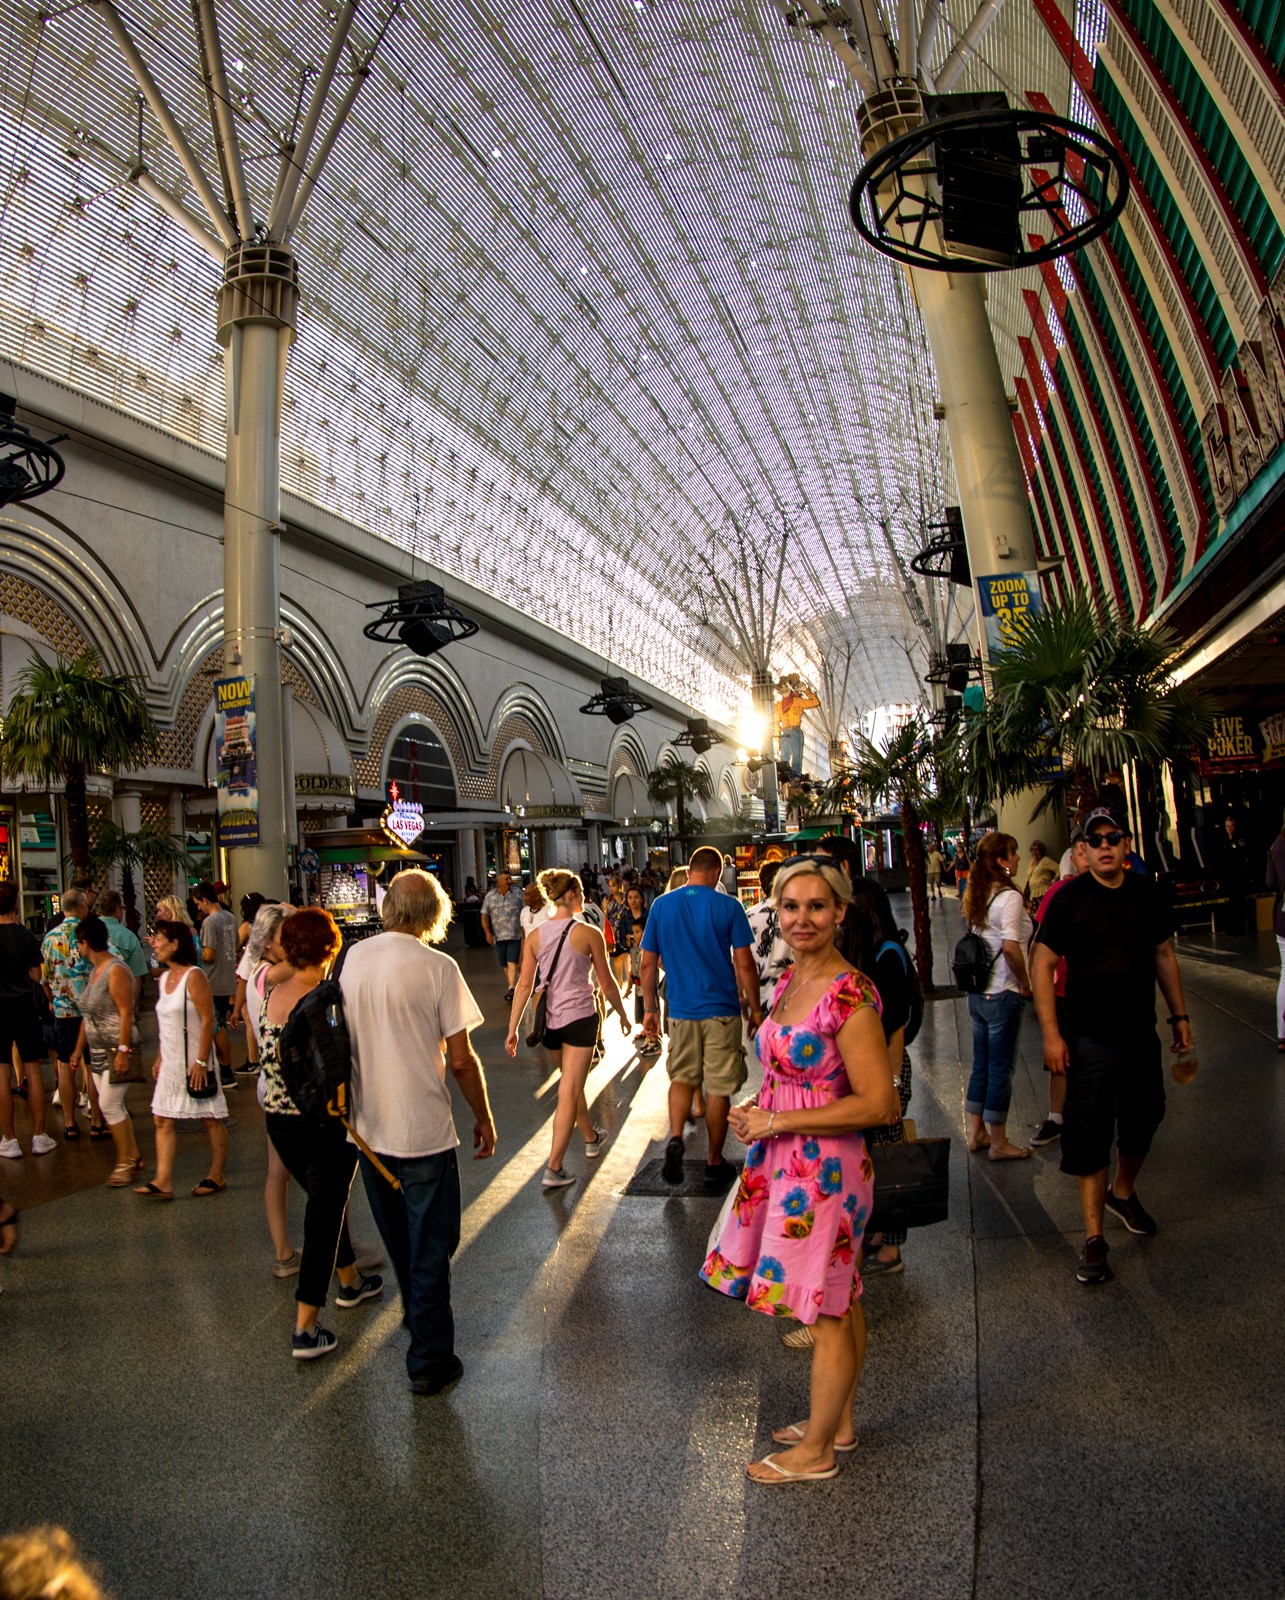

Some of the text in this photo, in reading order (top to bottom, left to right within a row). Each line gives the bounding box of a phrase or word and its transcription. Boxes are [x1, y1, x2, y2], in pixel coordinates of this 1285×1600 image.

[989, 578, 1027, 594] ZOOM
[991, 592, 1030, 609] UP TO
[217, 679, 252, 702] NOW
[218, 697, 251, 711] LAUNCHING
[1212, 716, 1244, 737] LIVE
[1207, 735, 1254, 757] POKER
[392, 819, 423, 831] LAS VEGAS
